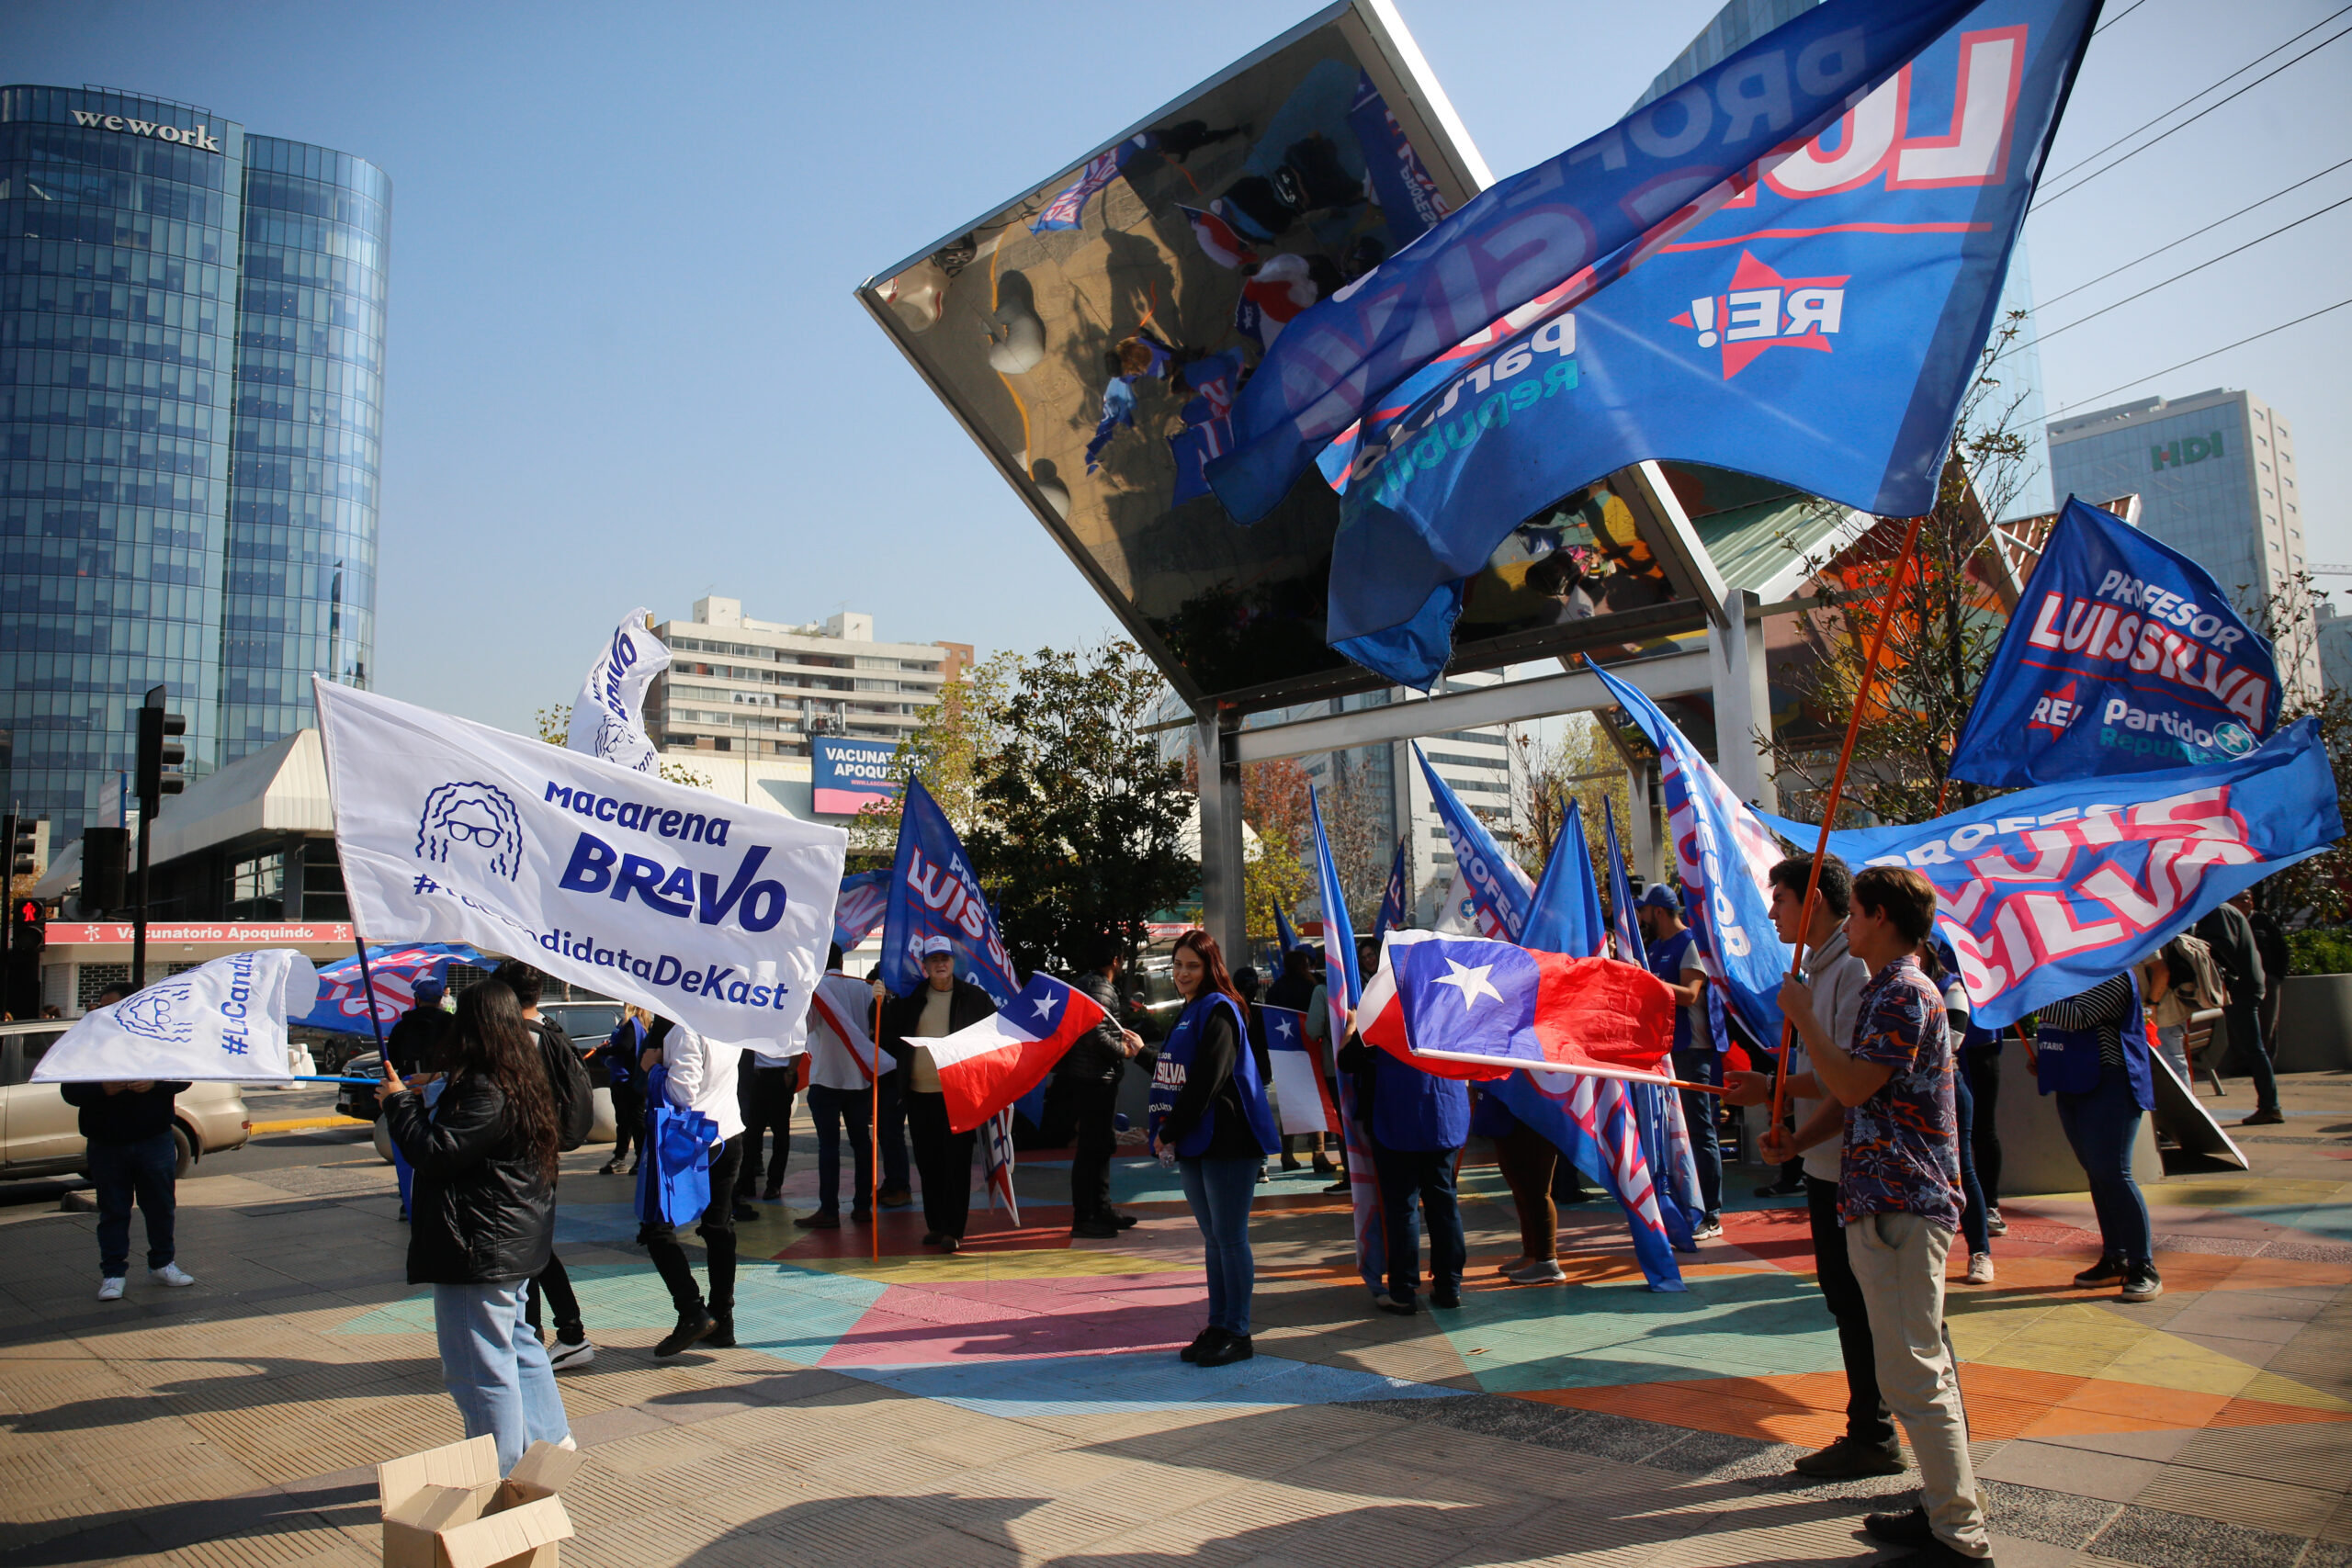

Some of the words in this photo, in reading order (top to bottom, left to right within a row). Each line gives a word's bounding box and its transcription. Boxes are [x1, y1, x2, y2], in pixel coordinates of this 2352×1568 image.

[71, 109, 220, 152] wework
[2151, 430, 2223, 472] HDI
[2096, 569, 2245, 654] PROFESOR
[2027, 591, 2142, 663] LUIS
[2128, 619, 2273, 737] SILVA
[2029, 695, 2084, 728] RE!
[2103, 698, 2215, 748] Partido
[544, 781, 732, 847] Macarena
[1865, 804, 2127, 867] PROFES
[559, 831, 787, 933] BRAVO
[907, 844, 986, 941] LUIS
[1444, 819, 1523, 939] PROFES
[1923, 784, 2250, 928] LUIS
[228, 926, 313, 942] Apoquindo
[1937, 837, 2266, 1009] SILVA
[1157, 1061, 1187, 1084] SILVA
